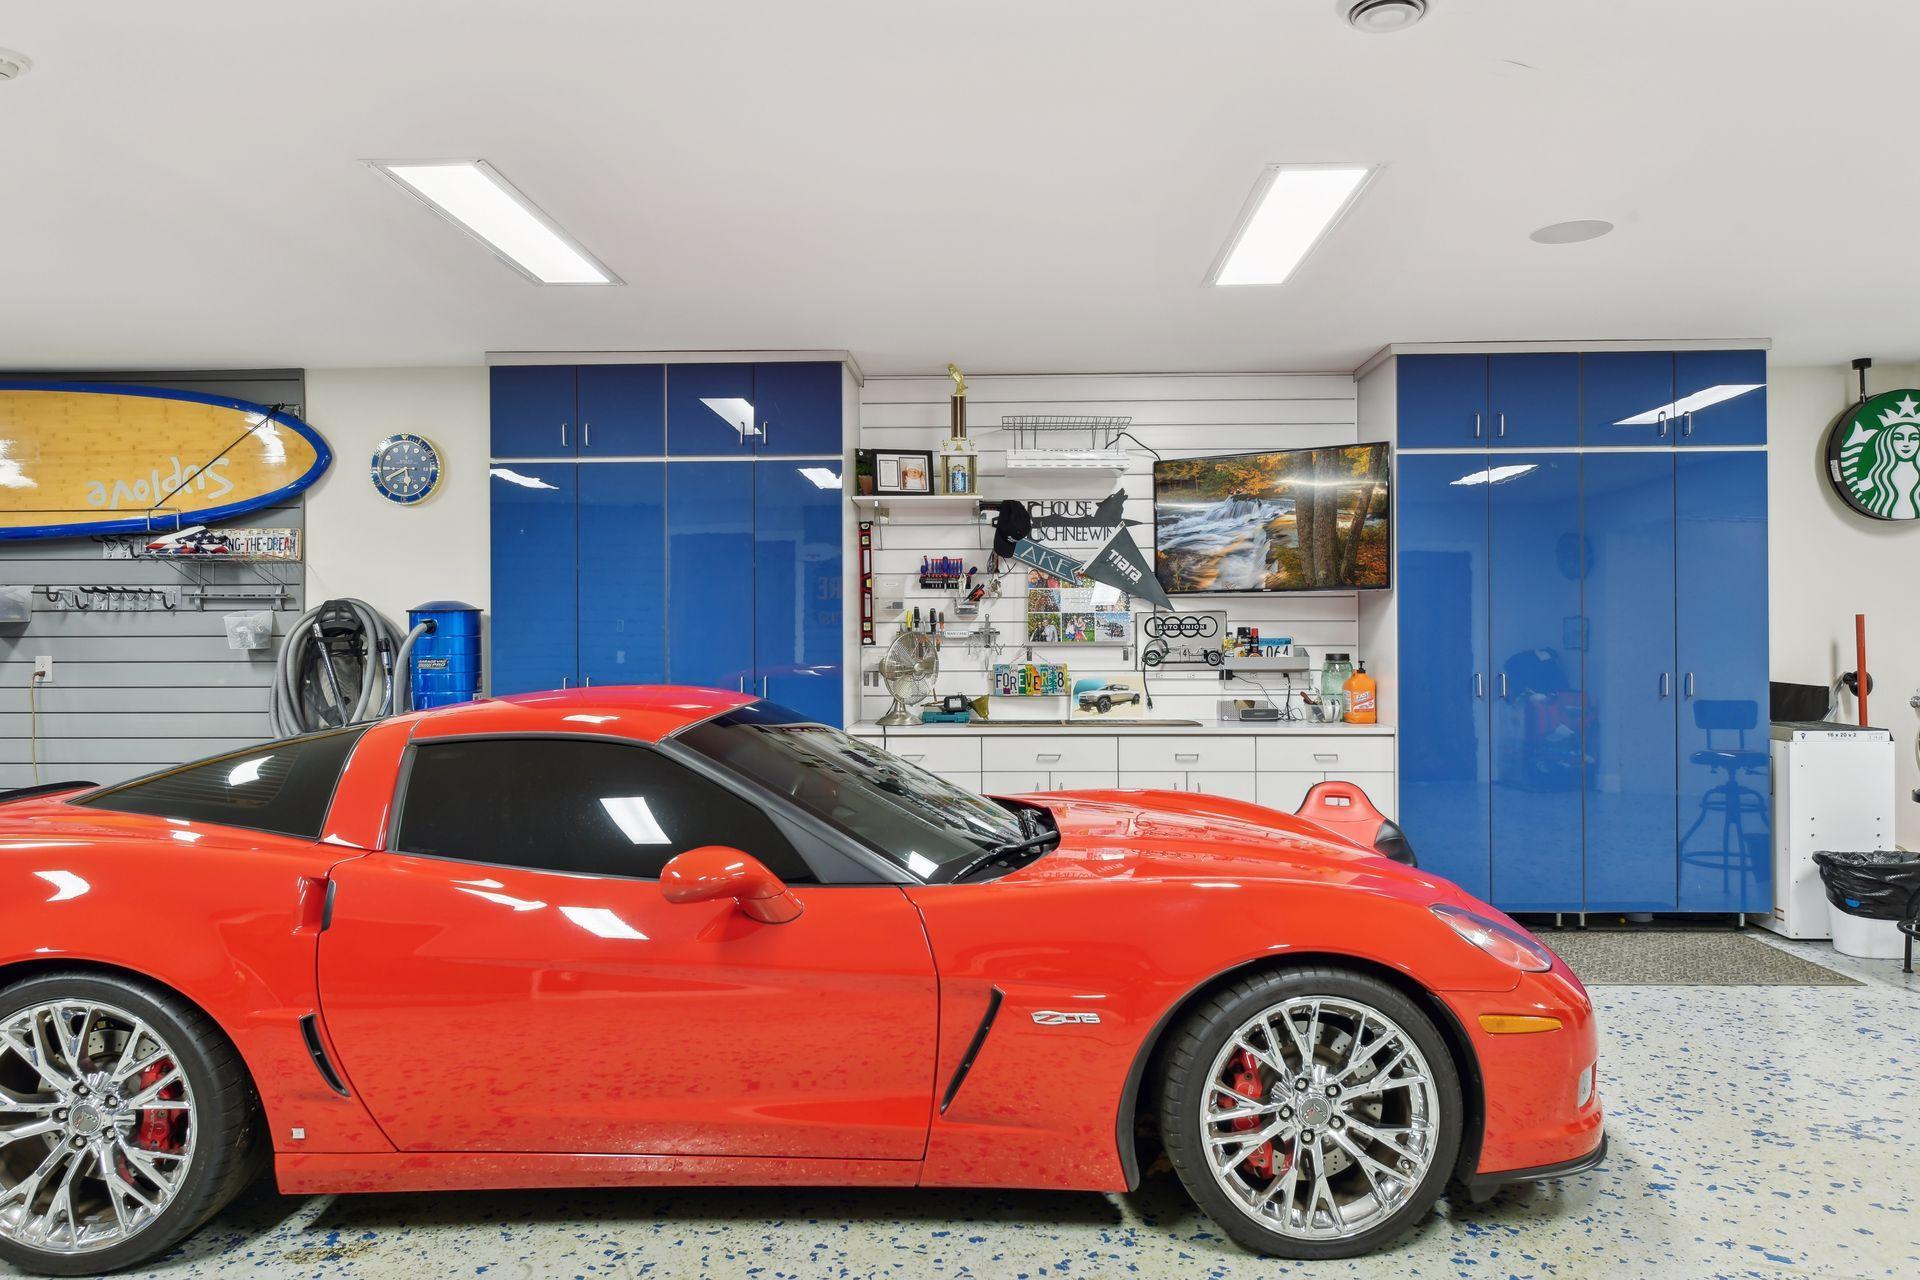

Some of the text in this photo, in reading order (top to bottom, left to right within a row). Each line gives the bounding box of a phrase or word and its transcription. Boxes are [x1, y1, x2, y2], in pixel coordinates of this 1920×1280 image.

[86, 456, 234, 510] Suplove
[1041, 501, 1091, 516] HOUSE
[225, 537, 296, 552] NG-THE-DREAM
[1019, 545, 1074, 577] AKE
[995, 671, 1048, 690] FOREVER
